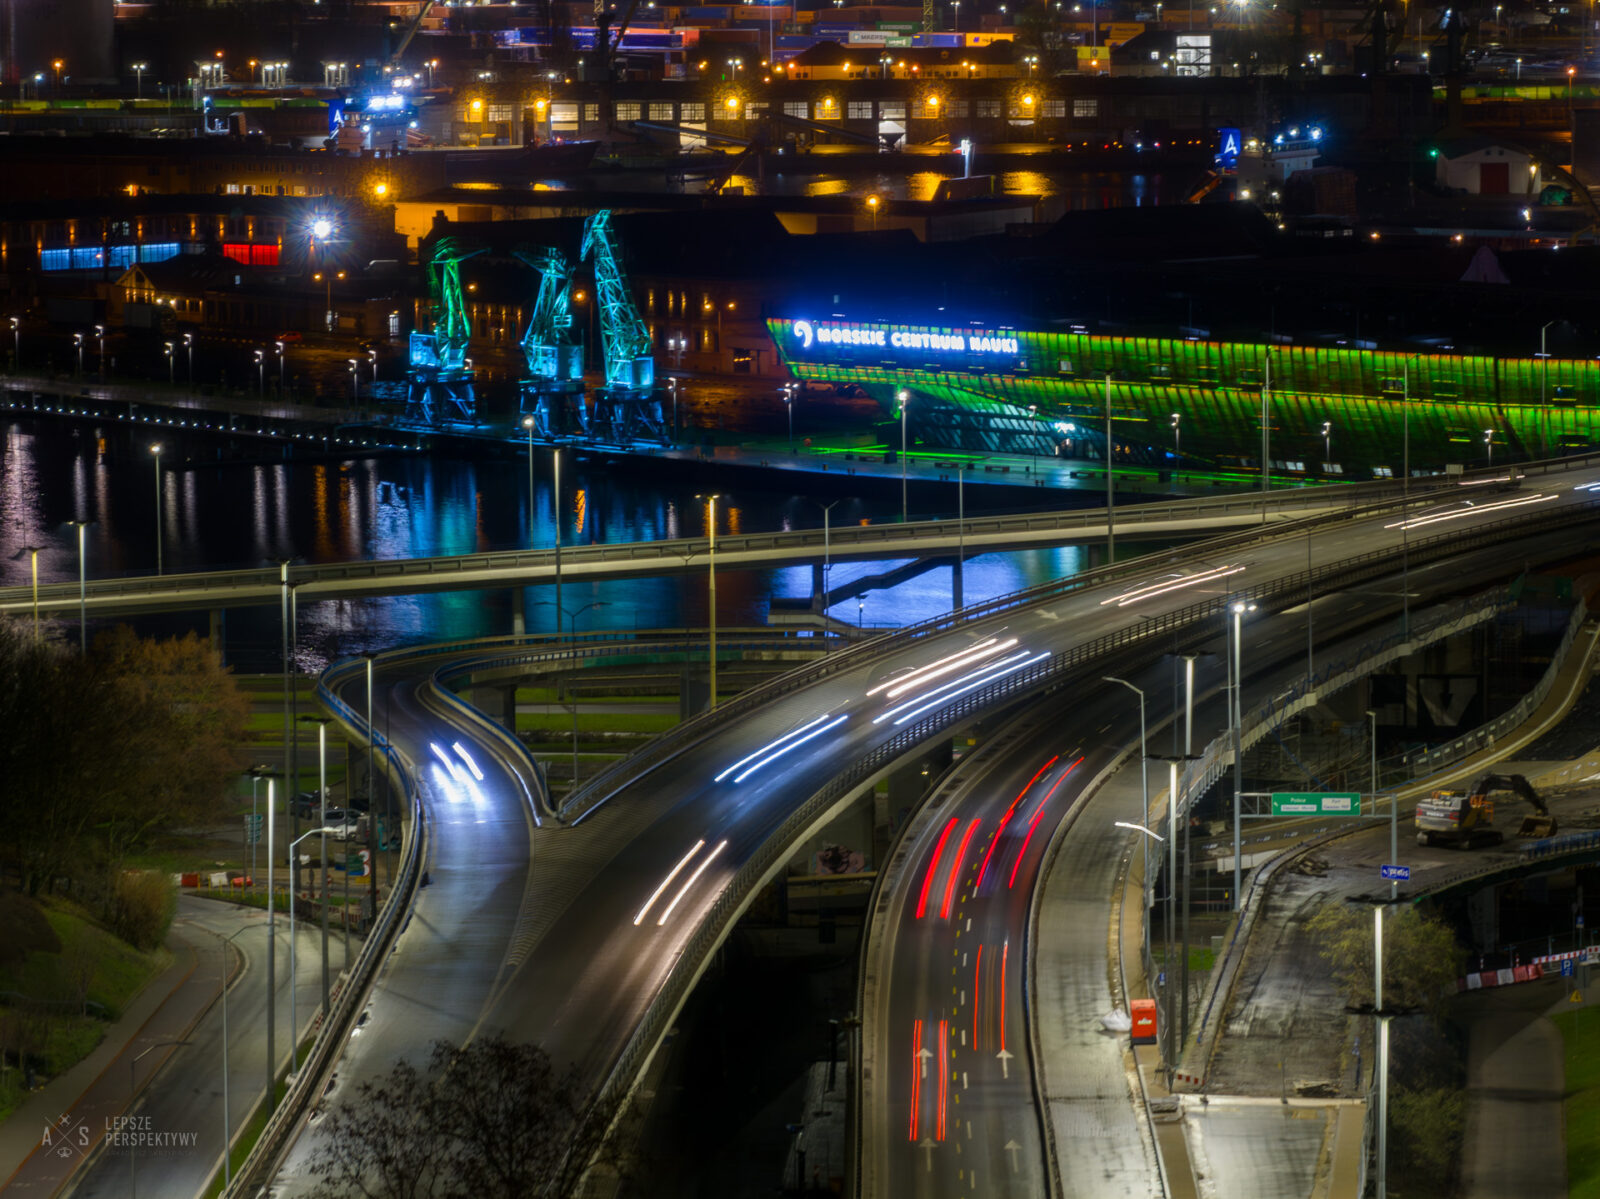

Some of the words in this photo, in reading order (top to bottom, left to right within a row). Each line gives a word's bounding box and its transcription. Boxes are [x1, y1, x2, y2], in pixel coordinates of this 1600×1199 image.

[817, 328, 886, 346] MORSKIE
[891, 332, 965, 351] CENTRUM
[969, 336, 1018, 354] NAUKI
